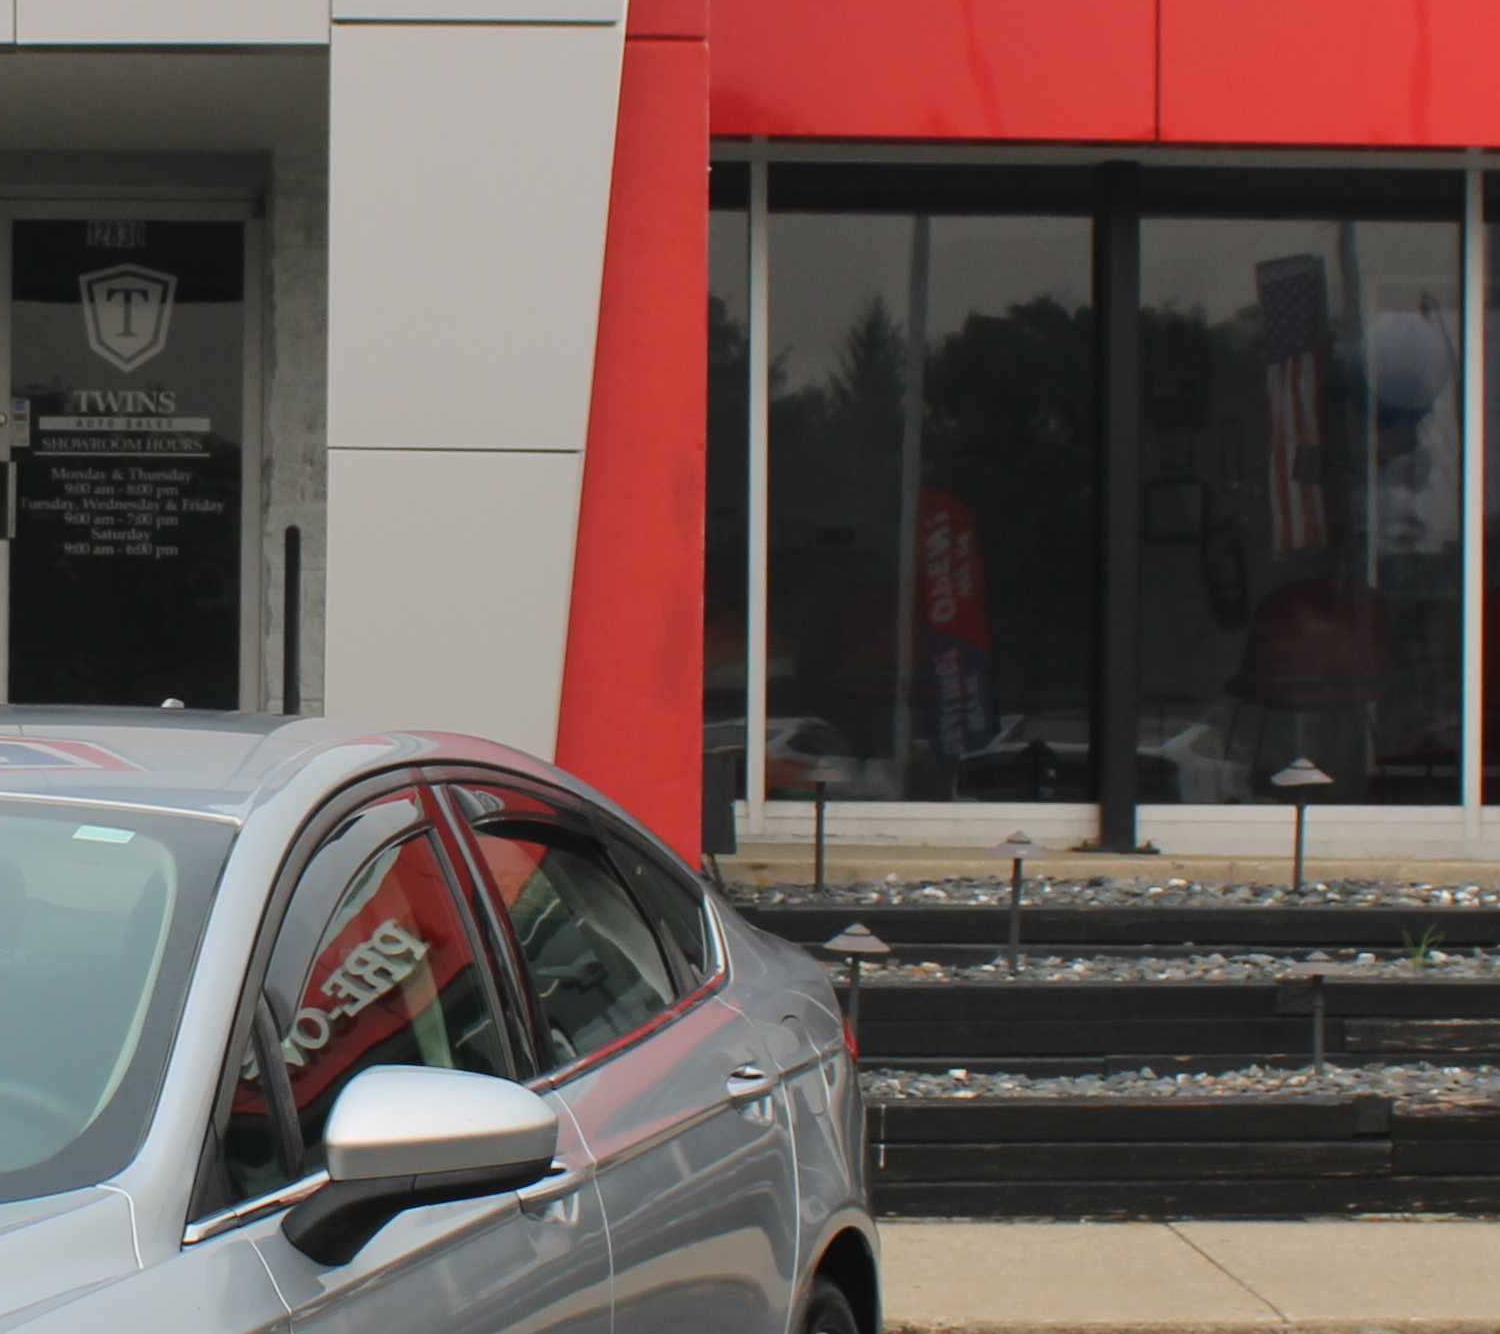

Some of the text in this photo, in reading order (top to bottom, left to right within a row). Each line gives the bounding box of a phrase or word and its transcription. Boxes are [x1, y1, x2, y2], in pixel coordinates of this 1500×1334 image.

[106, 288, 149, 337] T
[73, 391, 176, 413] TWINS
[41, 437, 203, 452] SHOWROOM HOURS
[51, 467, 192, 484] Monday & Thursday
[64, 483, 90, 496] 9:00
[93, 486, 115, 496] am
[156, 485, 179, 500] pm
[82, 497, 160, 513] Wednesday
[165, 498, 178, 511] &
[181, 497, 225, 514] Friday
[64, 513, 90, 526] 9:00
[93, 516, 115, 526] am
[127, 513, 153, 526] 7:00
[156, 515, 179, 530] pm
[90, 527, 151, 542] Saturday
[64, 543, 90, 556] 9:00
[93, 546, 115, 556] am
[156, 545, 179, 560] pm
